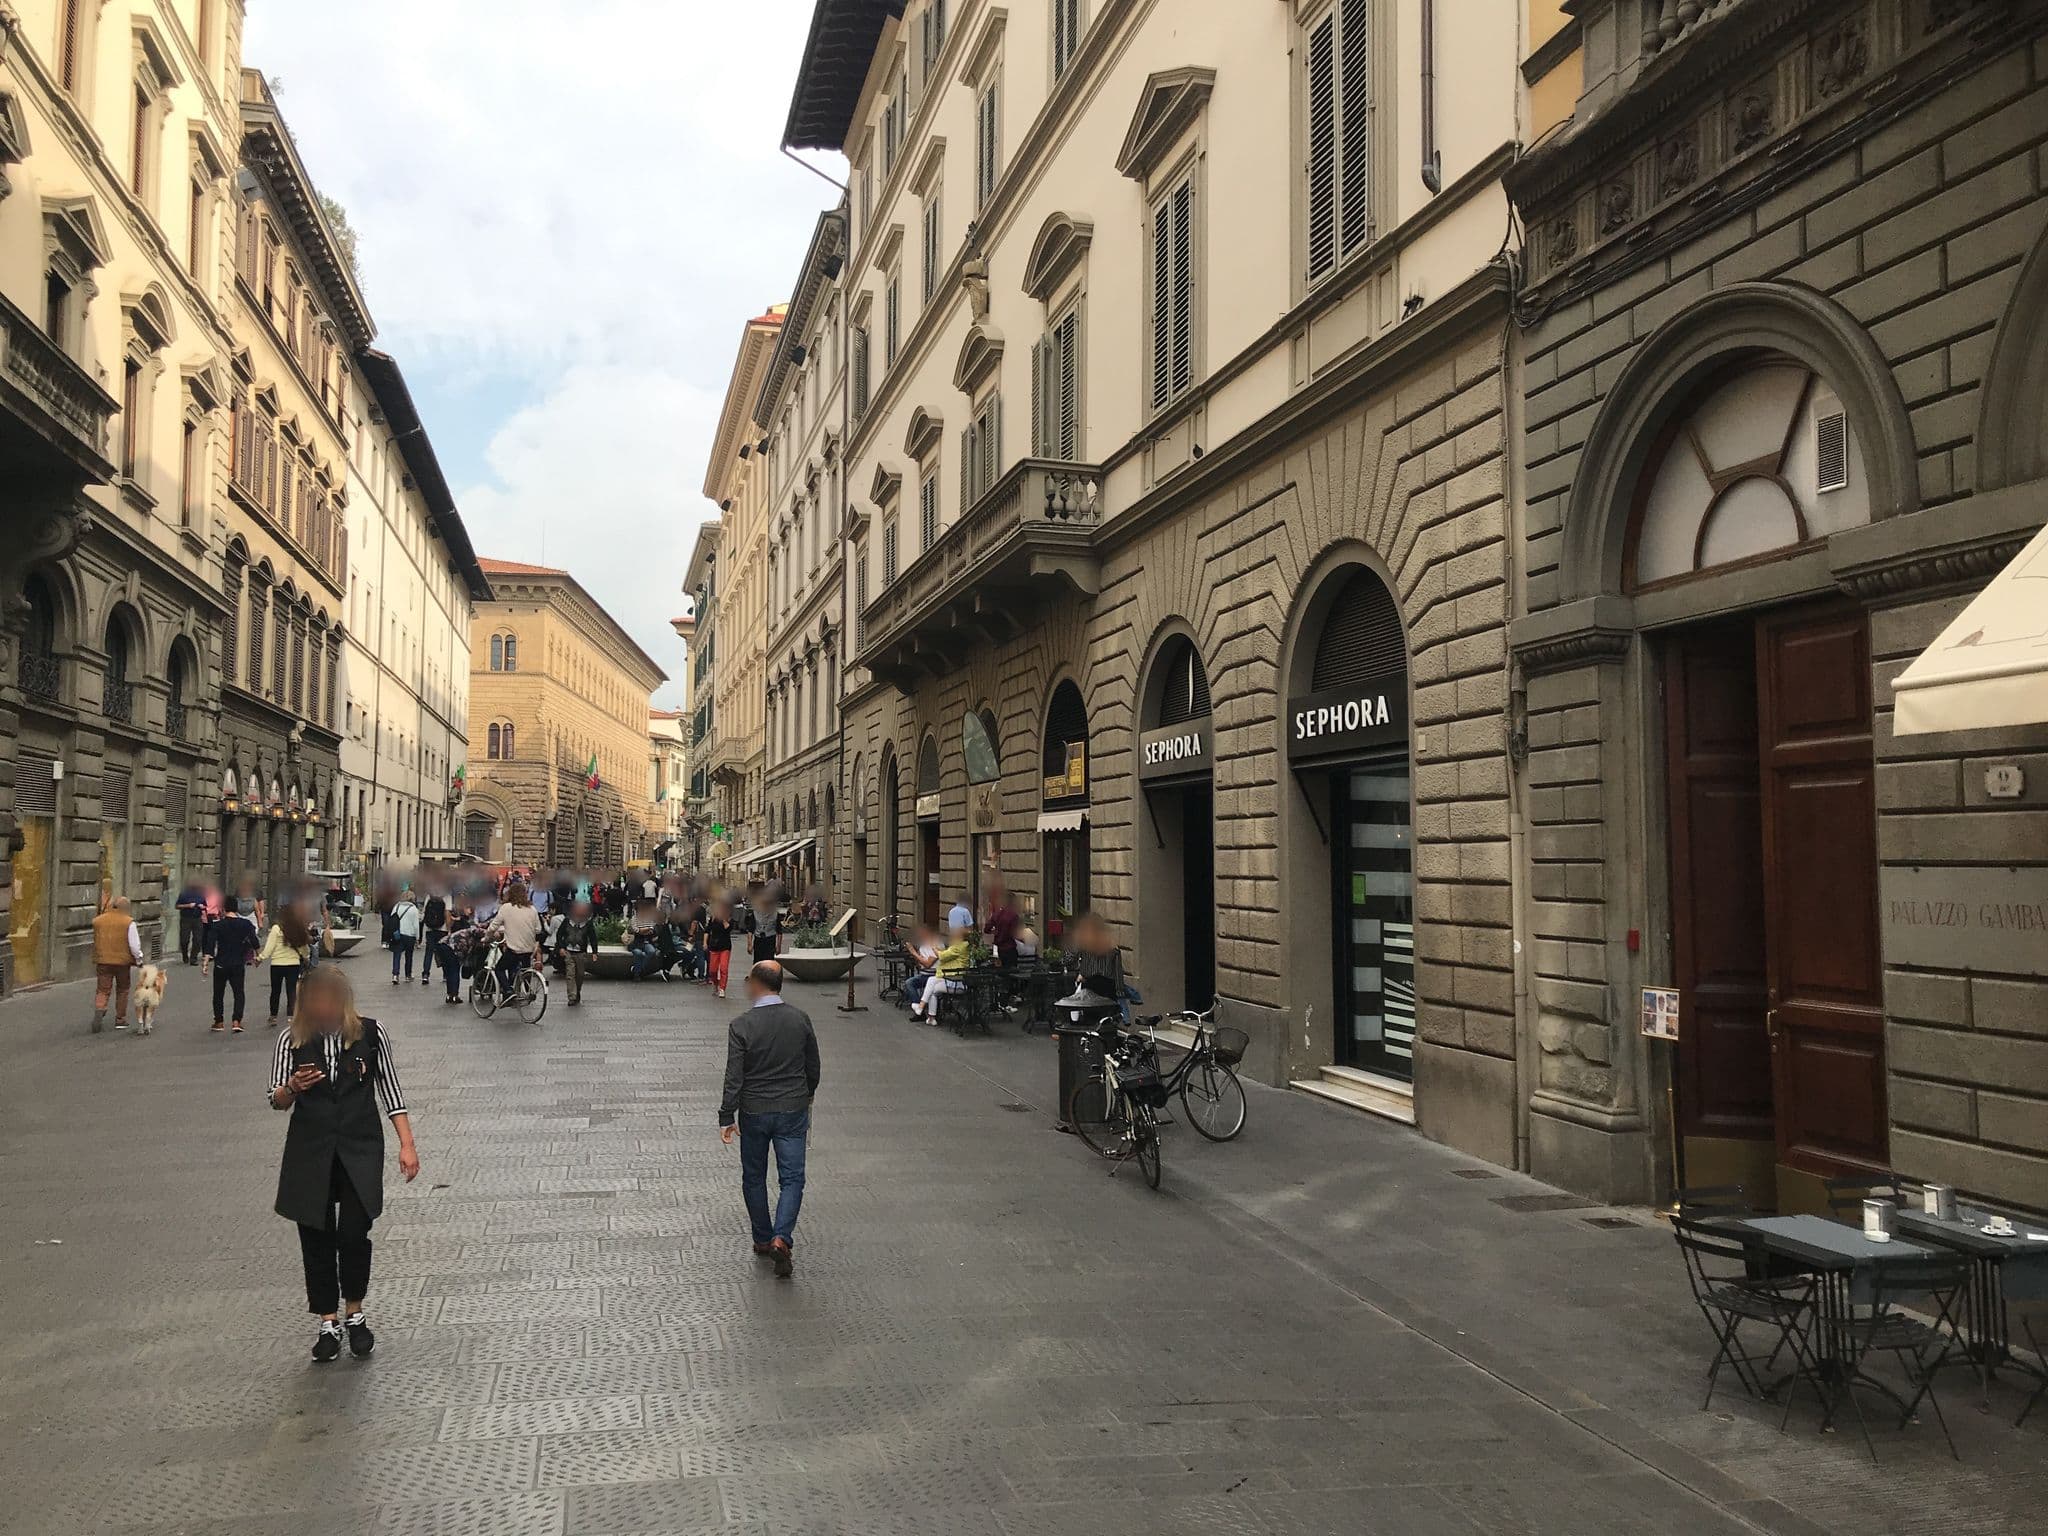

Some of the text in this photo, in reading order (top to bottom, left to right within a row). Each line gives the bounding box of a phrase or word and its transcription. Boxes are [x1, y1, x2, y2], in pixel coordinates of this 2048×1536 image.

[1295, 695, 1390, 740] SEPHORA
[1145, 733, 1201, 765] SEPHORA
[1891, 901, 2048, 931] PALAZZO GAMBA
